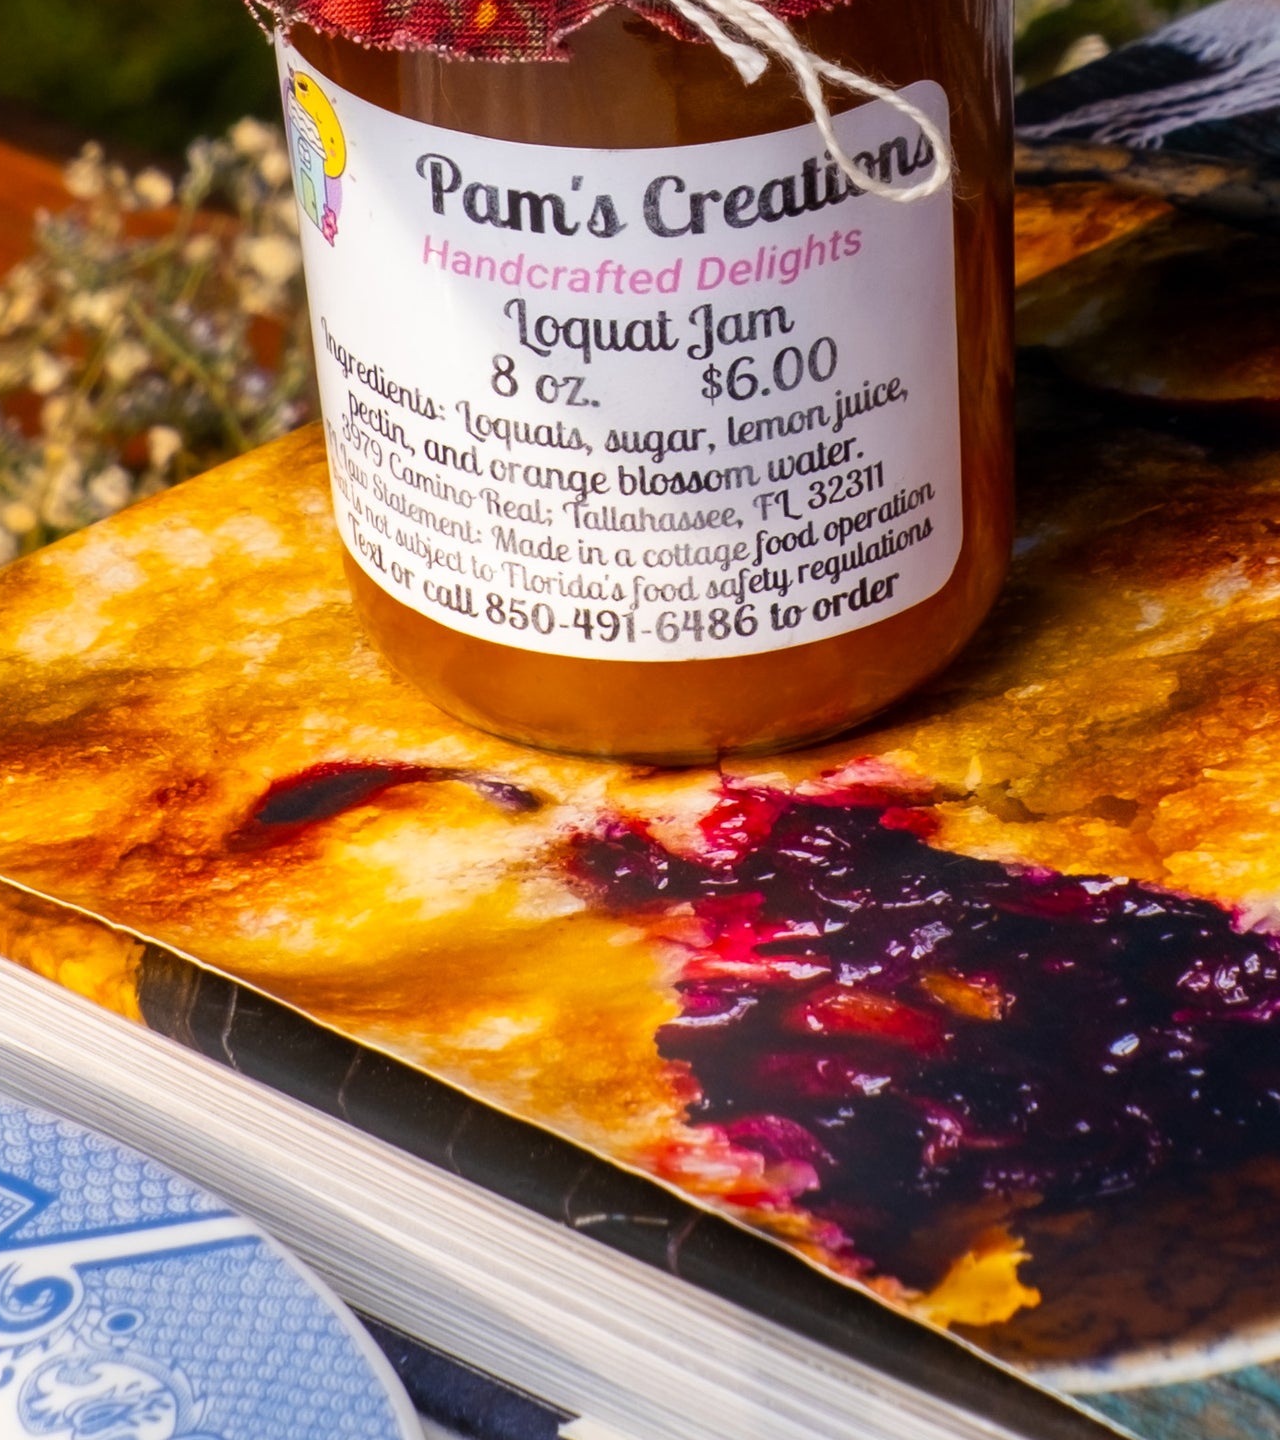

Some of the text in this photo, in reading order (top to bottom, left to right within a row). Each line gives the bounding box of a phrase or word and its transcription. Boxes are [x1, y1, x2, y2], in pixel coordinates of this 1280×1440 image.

[415, 131, 935, 238] Pam's Creations
[422, 228, 863, 295] Handcrafted Delights
[491, 336, 838, 408] 8 oz. $6.00
[504, 298, 795, 364] Loquat Jam
[321, 316, 908, 464] Ingredients: Loquats, sugar, lemon juice,
[341, 413, 885, 532] 3979 Camino Real; Tallahassee, FL 32311
[348, 390, 864, 503] pectin, and orange blossom water.
[364, 504, 392, 540] not
[395, 527, 467, 575] subject
[471, 555, 498, 583] to
[501, 560, 628, 602] Florida's
[629, 575, 700, 610] food
[706, 566, 793, 605] safety
[797, 516, 934, 584] regulations
[372, 476, 483, 544] Statement:
[491, 524, 572, 562] Made
[577, 539, 609, 566] in
[614, 547, 637, 567] a
[642, 540, 750, 571] cottage
[752, 520, 819, 567] food
[824, 482, 936, 547] operation
[348, 512, 900, 643] Text or call 850-491-6486 to order
